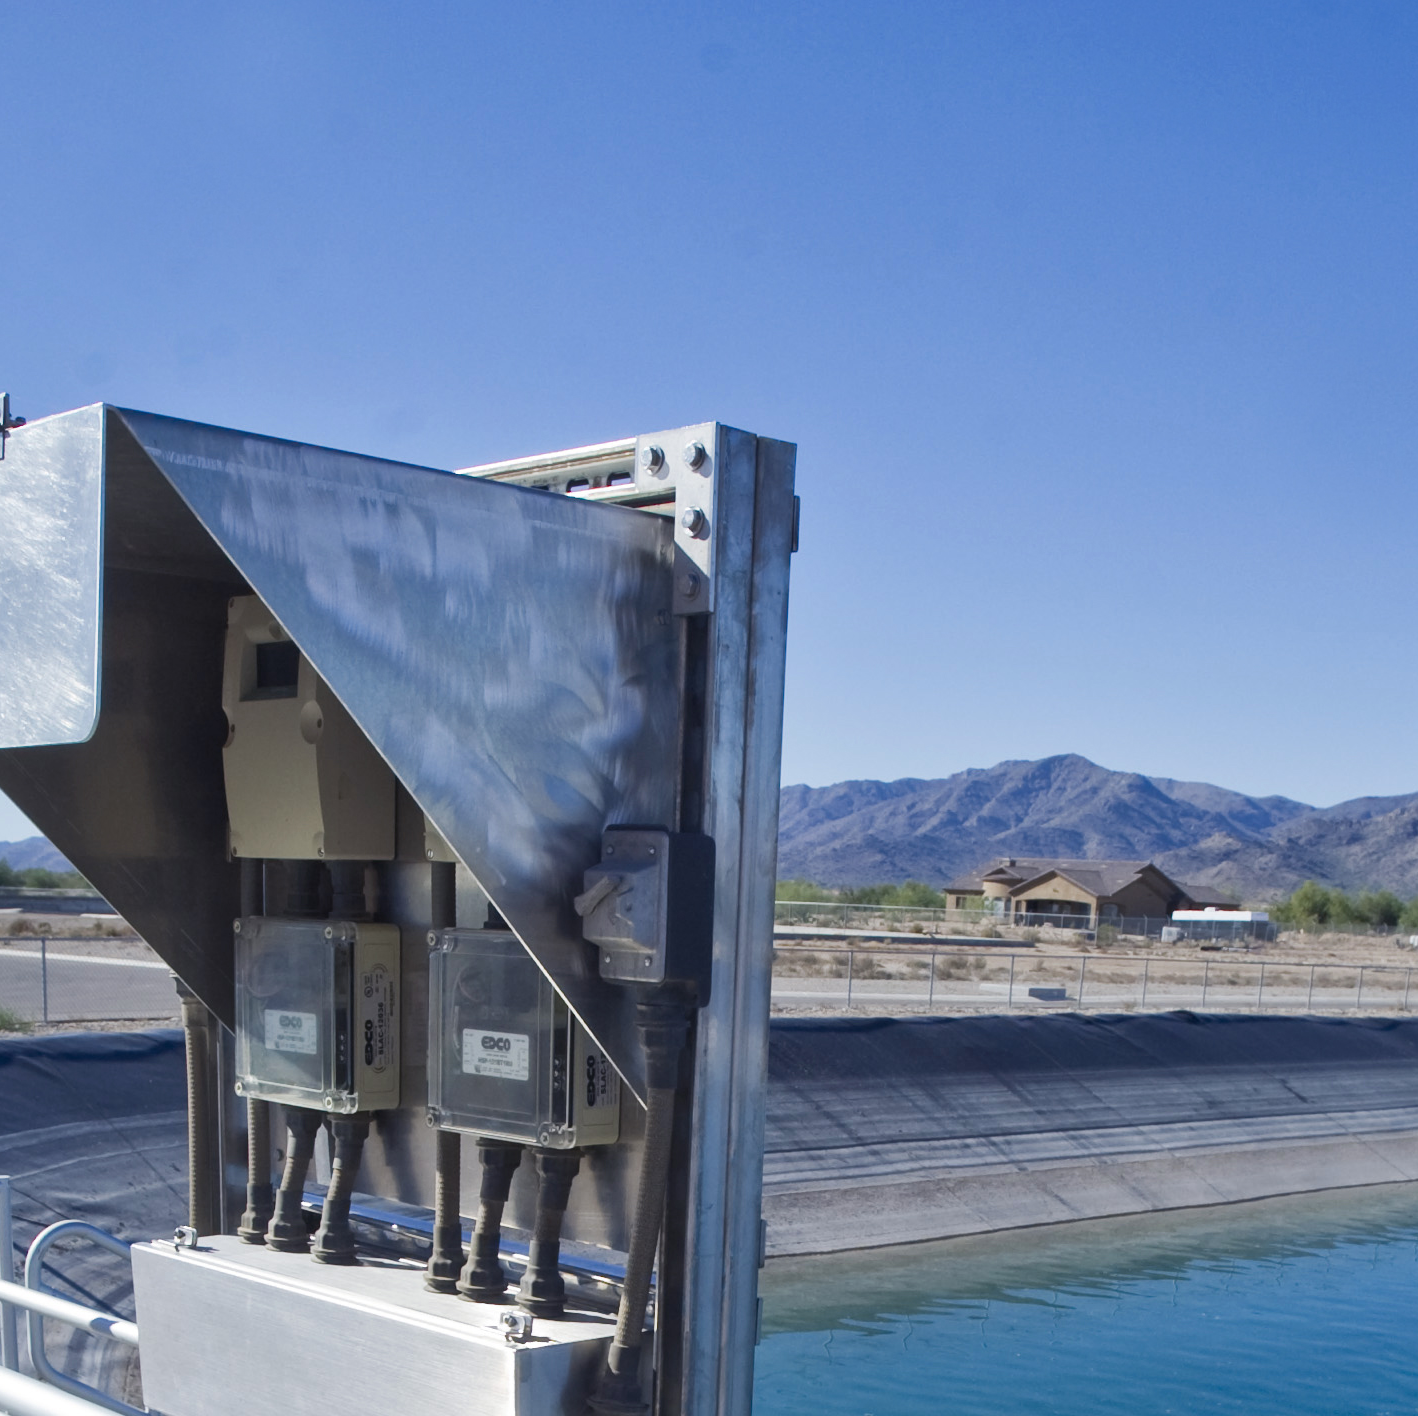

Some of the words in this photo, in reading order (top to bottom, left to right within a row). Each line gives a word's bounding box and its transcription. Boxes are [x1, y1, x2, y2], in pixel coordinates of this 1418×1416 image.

[365, 1019, 374, 1066] EDCO
[481, 1036, 511, 1051] EDCO
[587, 1054, 596, 1107] EDCO
